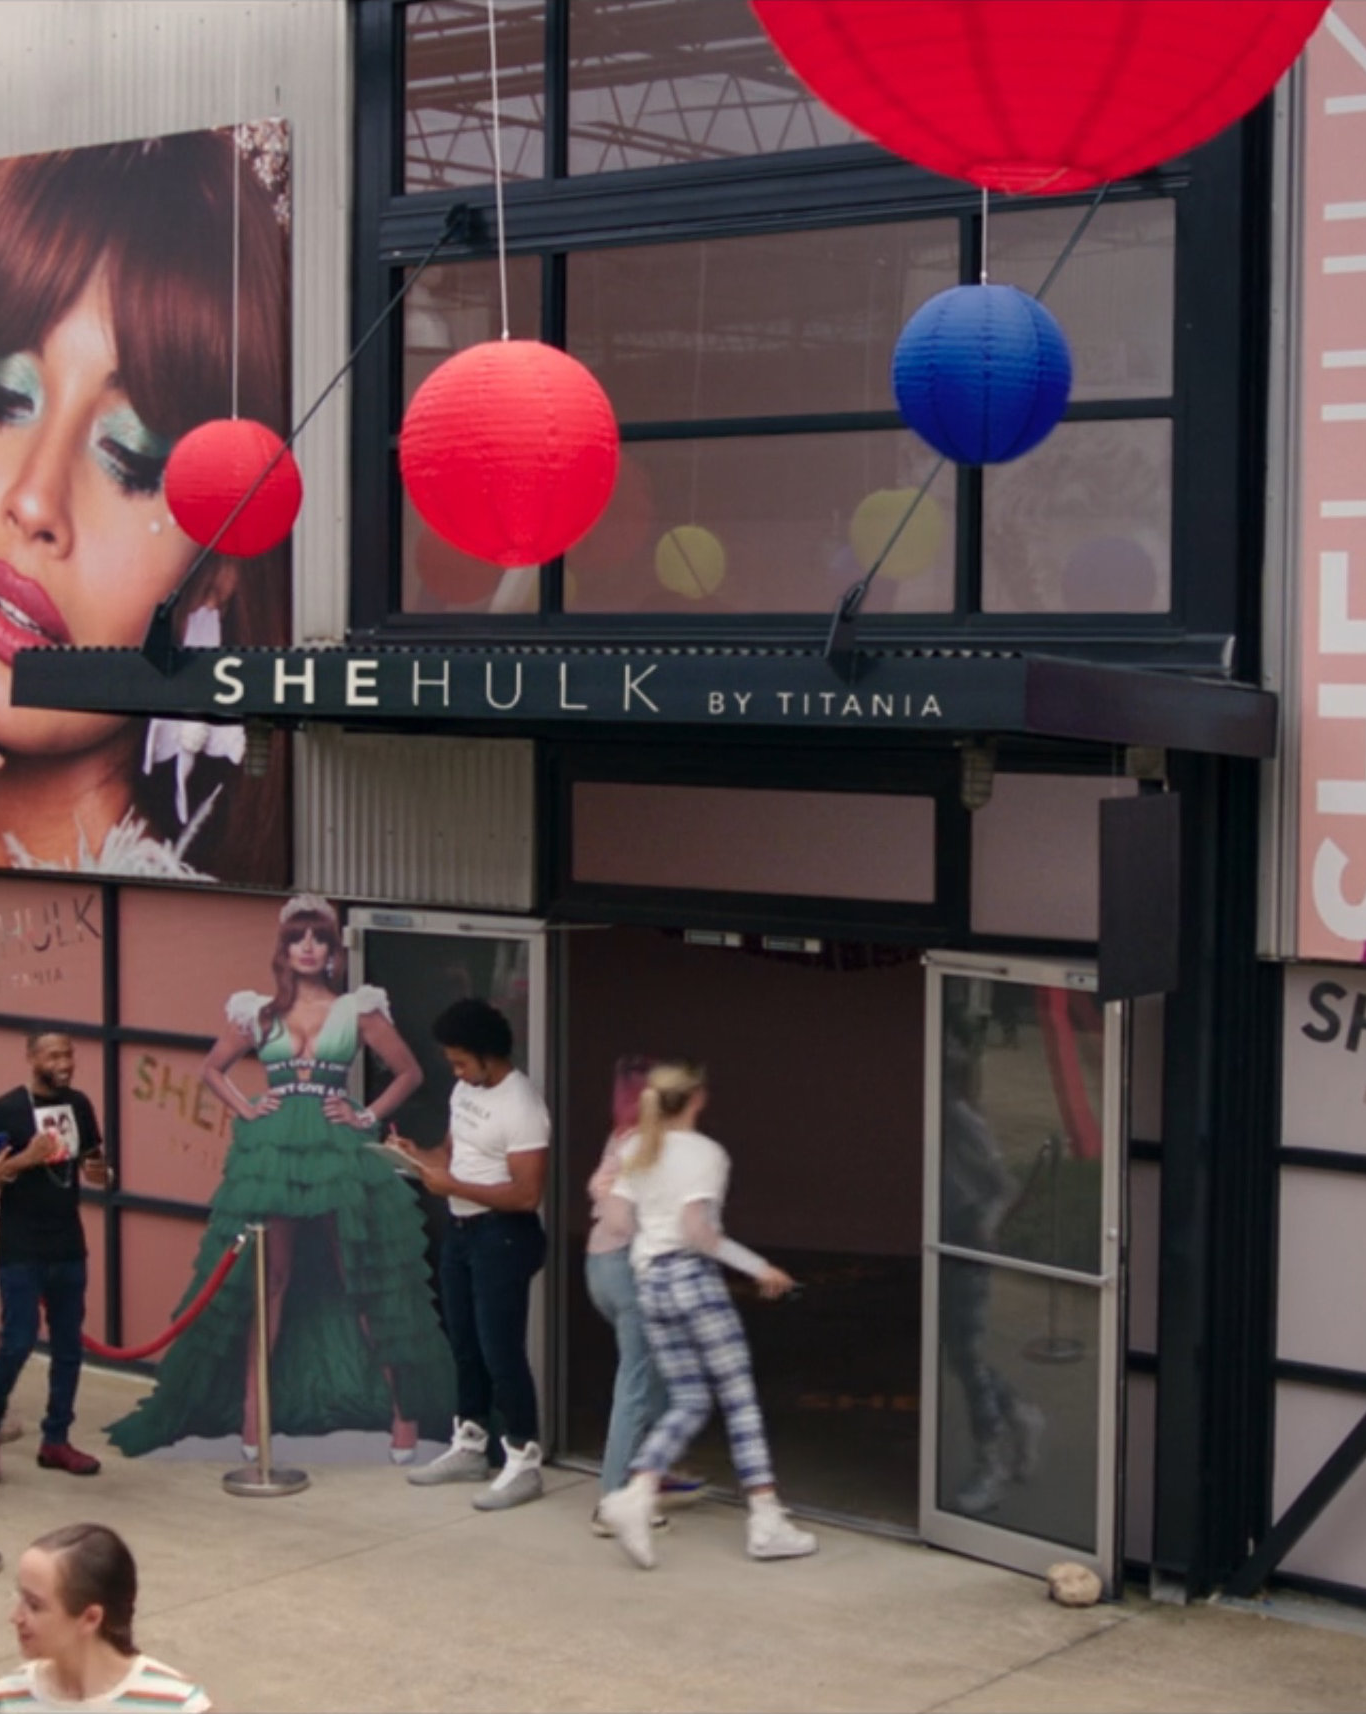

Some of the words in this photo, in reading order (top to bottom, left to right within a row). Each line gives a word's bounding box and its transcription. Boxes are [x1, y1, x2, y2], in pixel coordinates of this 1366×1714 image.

[213, 657, 660, 713] SHEHULK
[708, 691, 752, 715] BY
[776, 692, 942, 718] TITANIA
